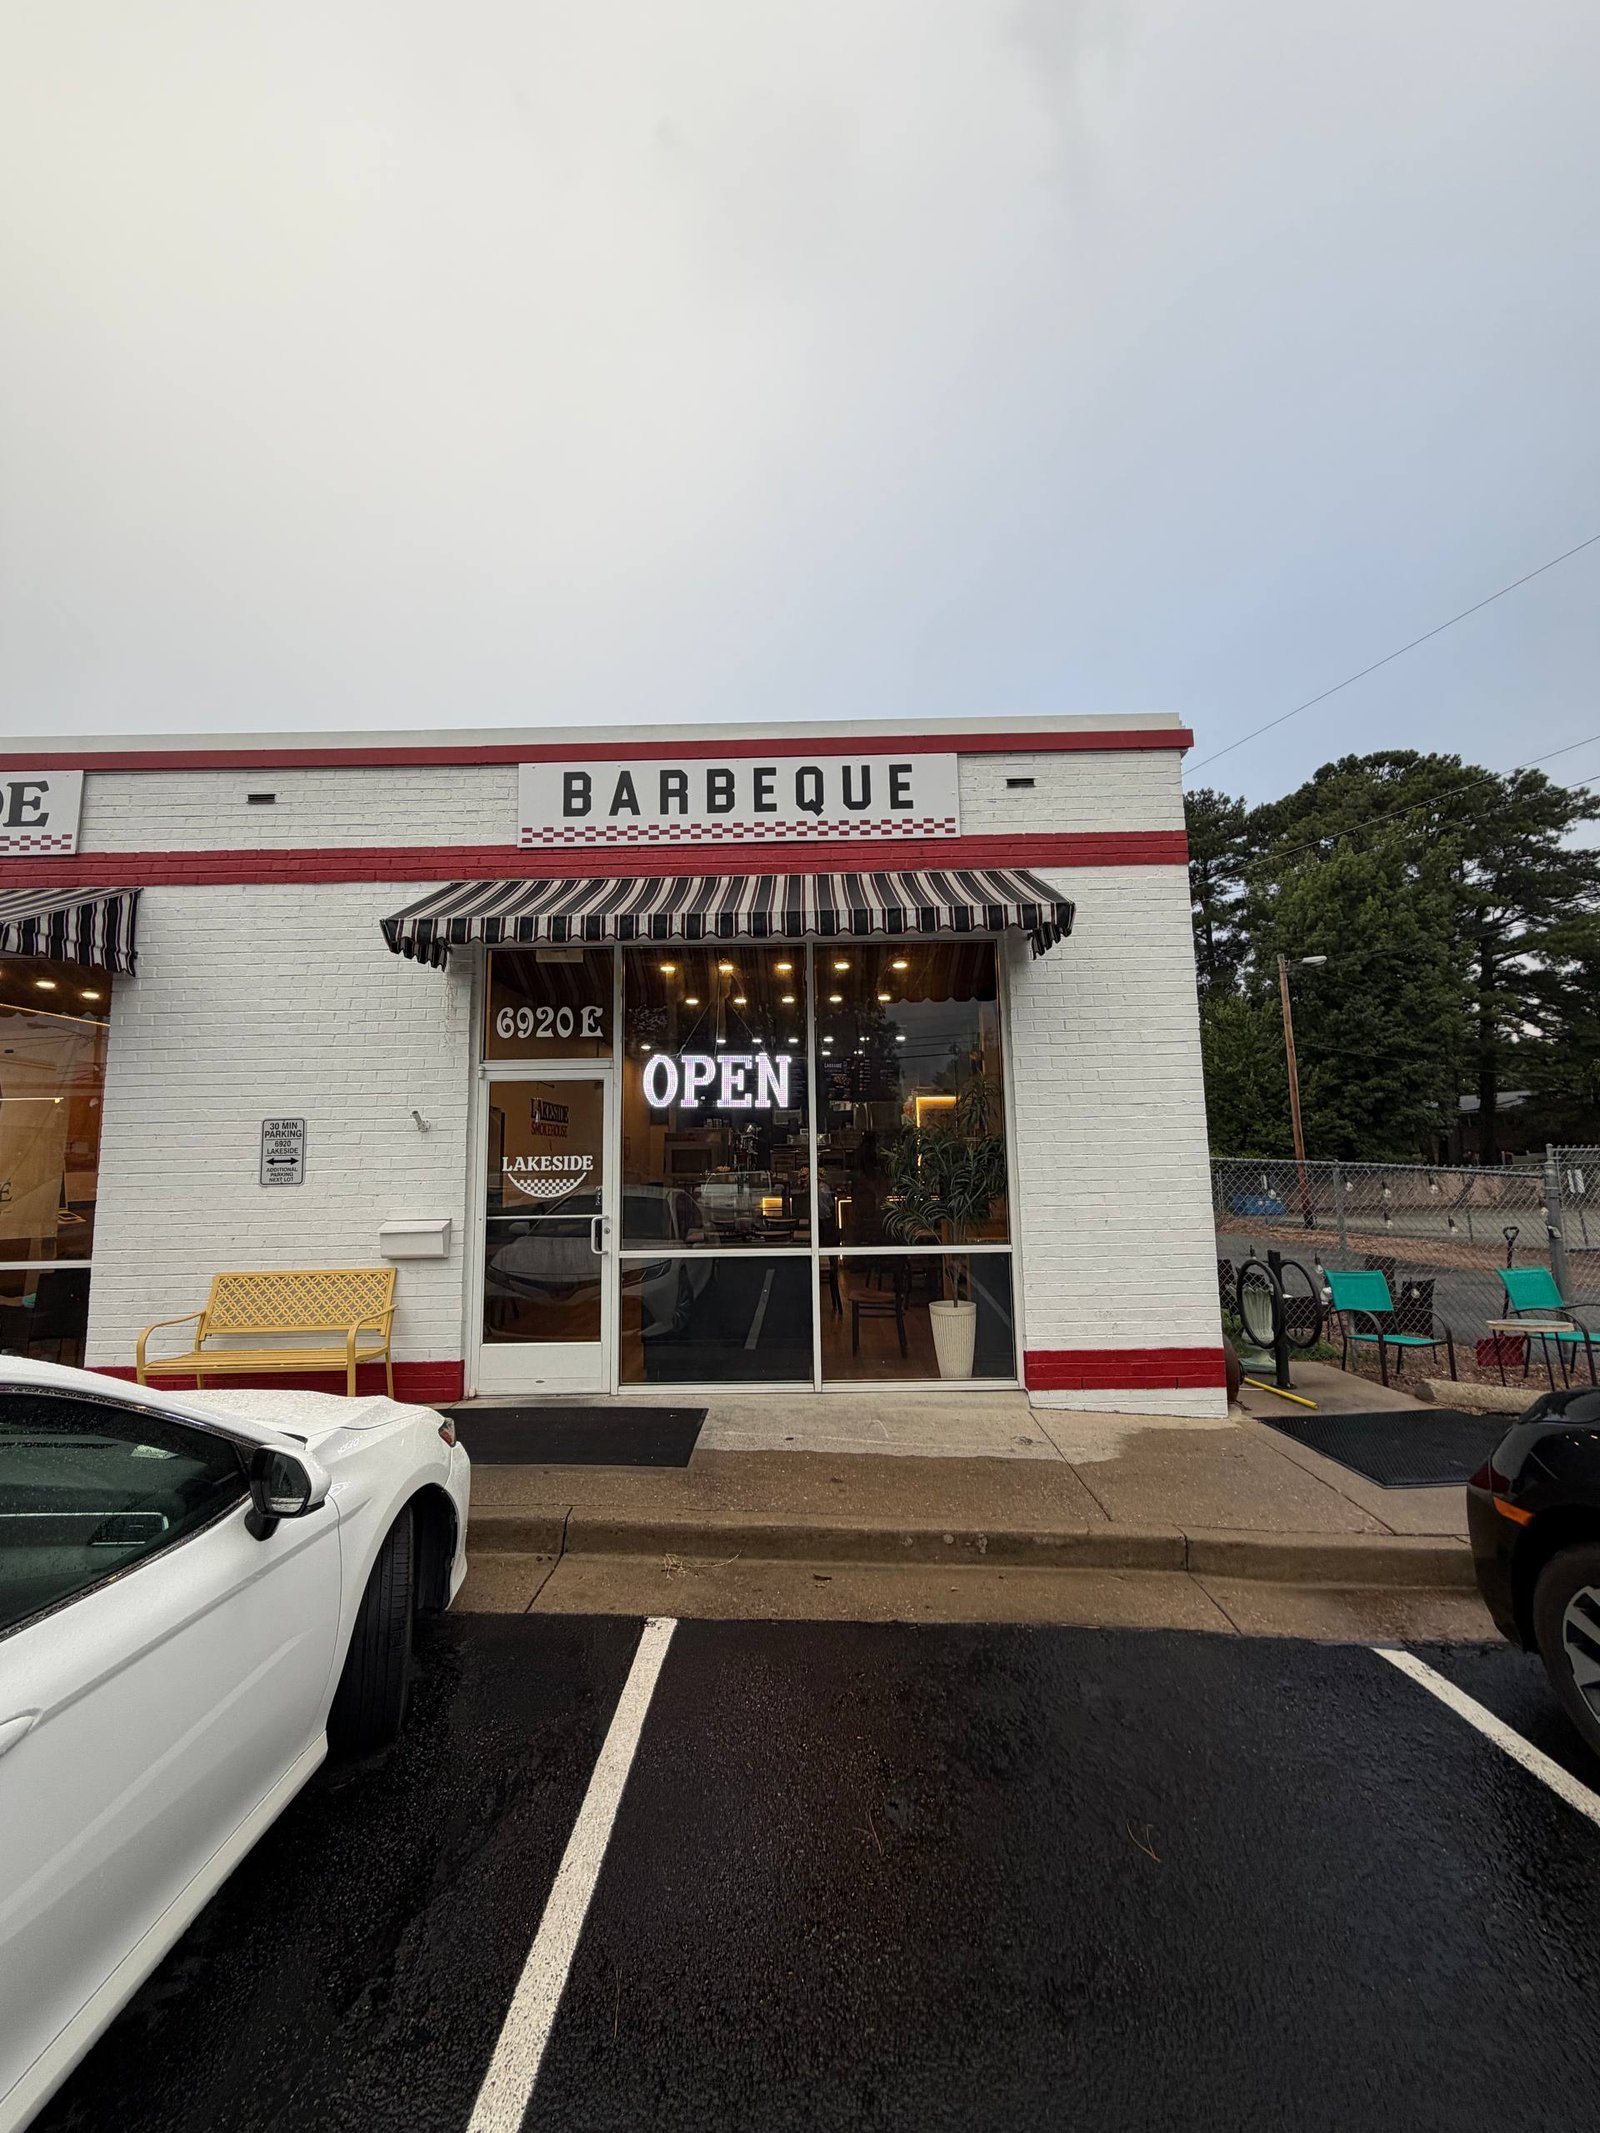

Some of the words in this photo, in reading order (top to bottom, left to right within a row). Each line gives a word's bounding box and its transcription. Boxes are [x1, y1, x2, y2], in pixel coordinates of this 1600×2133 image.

[563, 764, 914, 817] BARBEQUE
[0, 780, 49, 828] E
[643, 1054, 791, 1108] OPEN
[264, 1130, 302, 1138] PARKING
[269, 1122, 280, 1130] 30
[530, 1121, 569, 1138] SMOKEHOUSE
[502, 1155, 594, 1172] LAKESIDE
